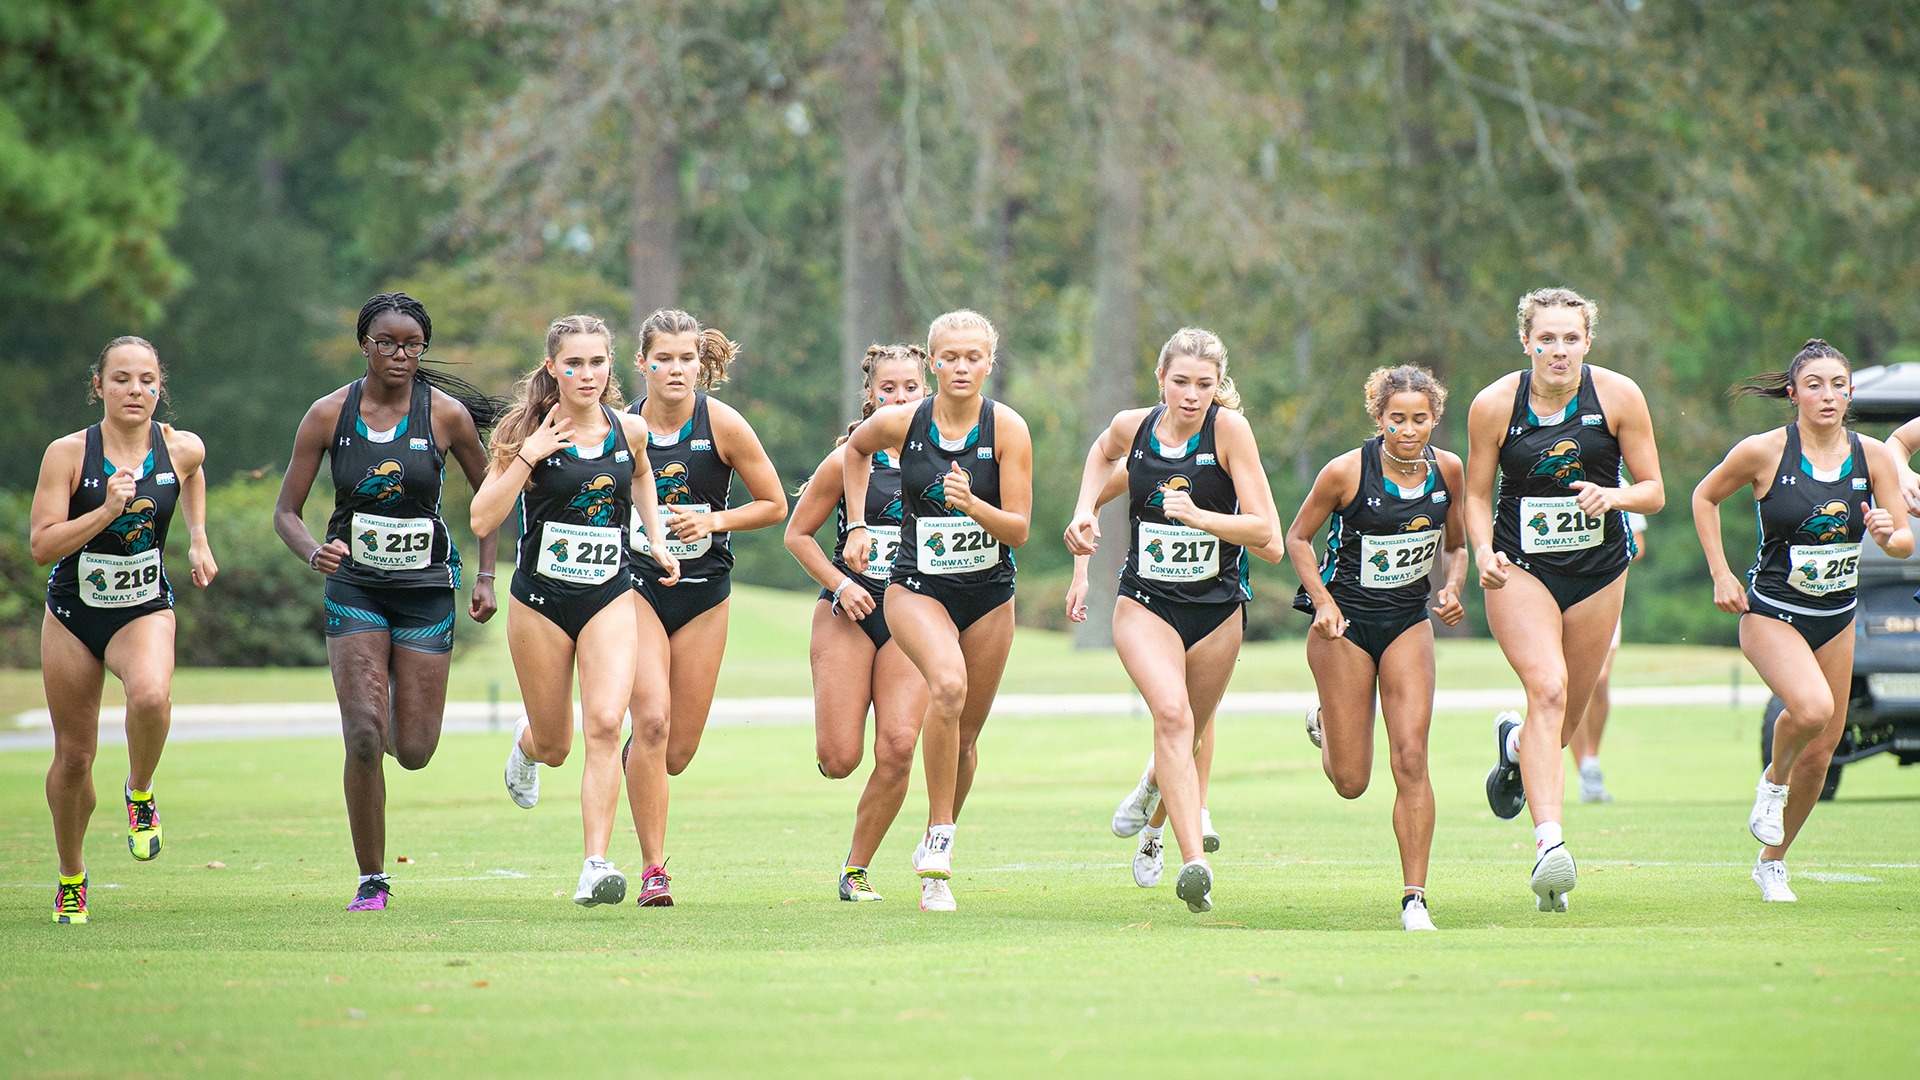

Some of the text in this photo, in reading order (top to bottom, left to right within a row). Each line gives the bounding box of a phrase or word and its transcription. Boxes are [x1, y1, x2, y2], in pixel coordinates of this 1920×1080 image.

[360, 518, 397, 528] CHANTICLEER
[1557, 511, 1601, 532] 216
[550, 527, 588, 536] CHANTICLEER
[1145, 527, 1180, 536] CHANTICLEER
[385, 532, 430, 552] 213
[952, 530, 997, 552] 220
[1578, 535, 1590, 543] SC
[576, 542, 618, 565] 212
[1172, 541, 1215, 562] 217
[1396, 542, 1436, 568] 222
[86, 556, 124, 566] CHANTICLEER
[405, 555, 417, 563] SC
[974, 555, 985, 563] SC
[1192, 566, 1204, 574] SC
[1414, 566, 1423, 575] SC
[1824, 556, 1859, 579] 215
[114, 564, 158, 590] 218
[594, 569, 606, 577] SC
[1838, 580, 1847, 588] SC
[136, 590, 148, 598] SC
